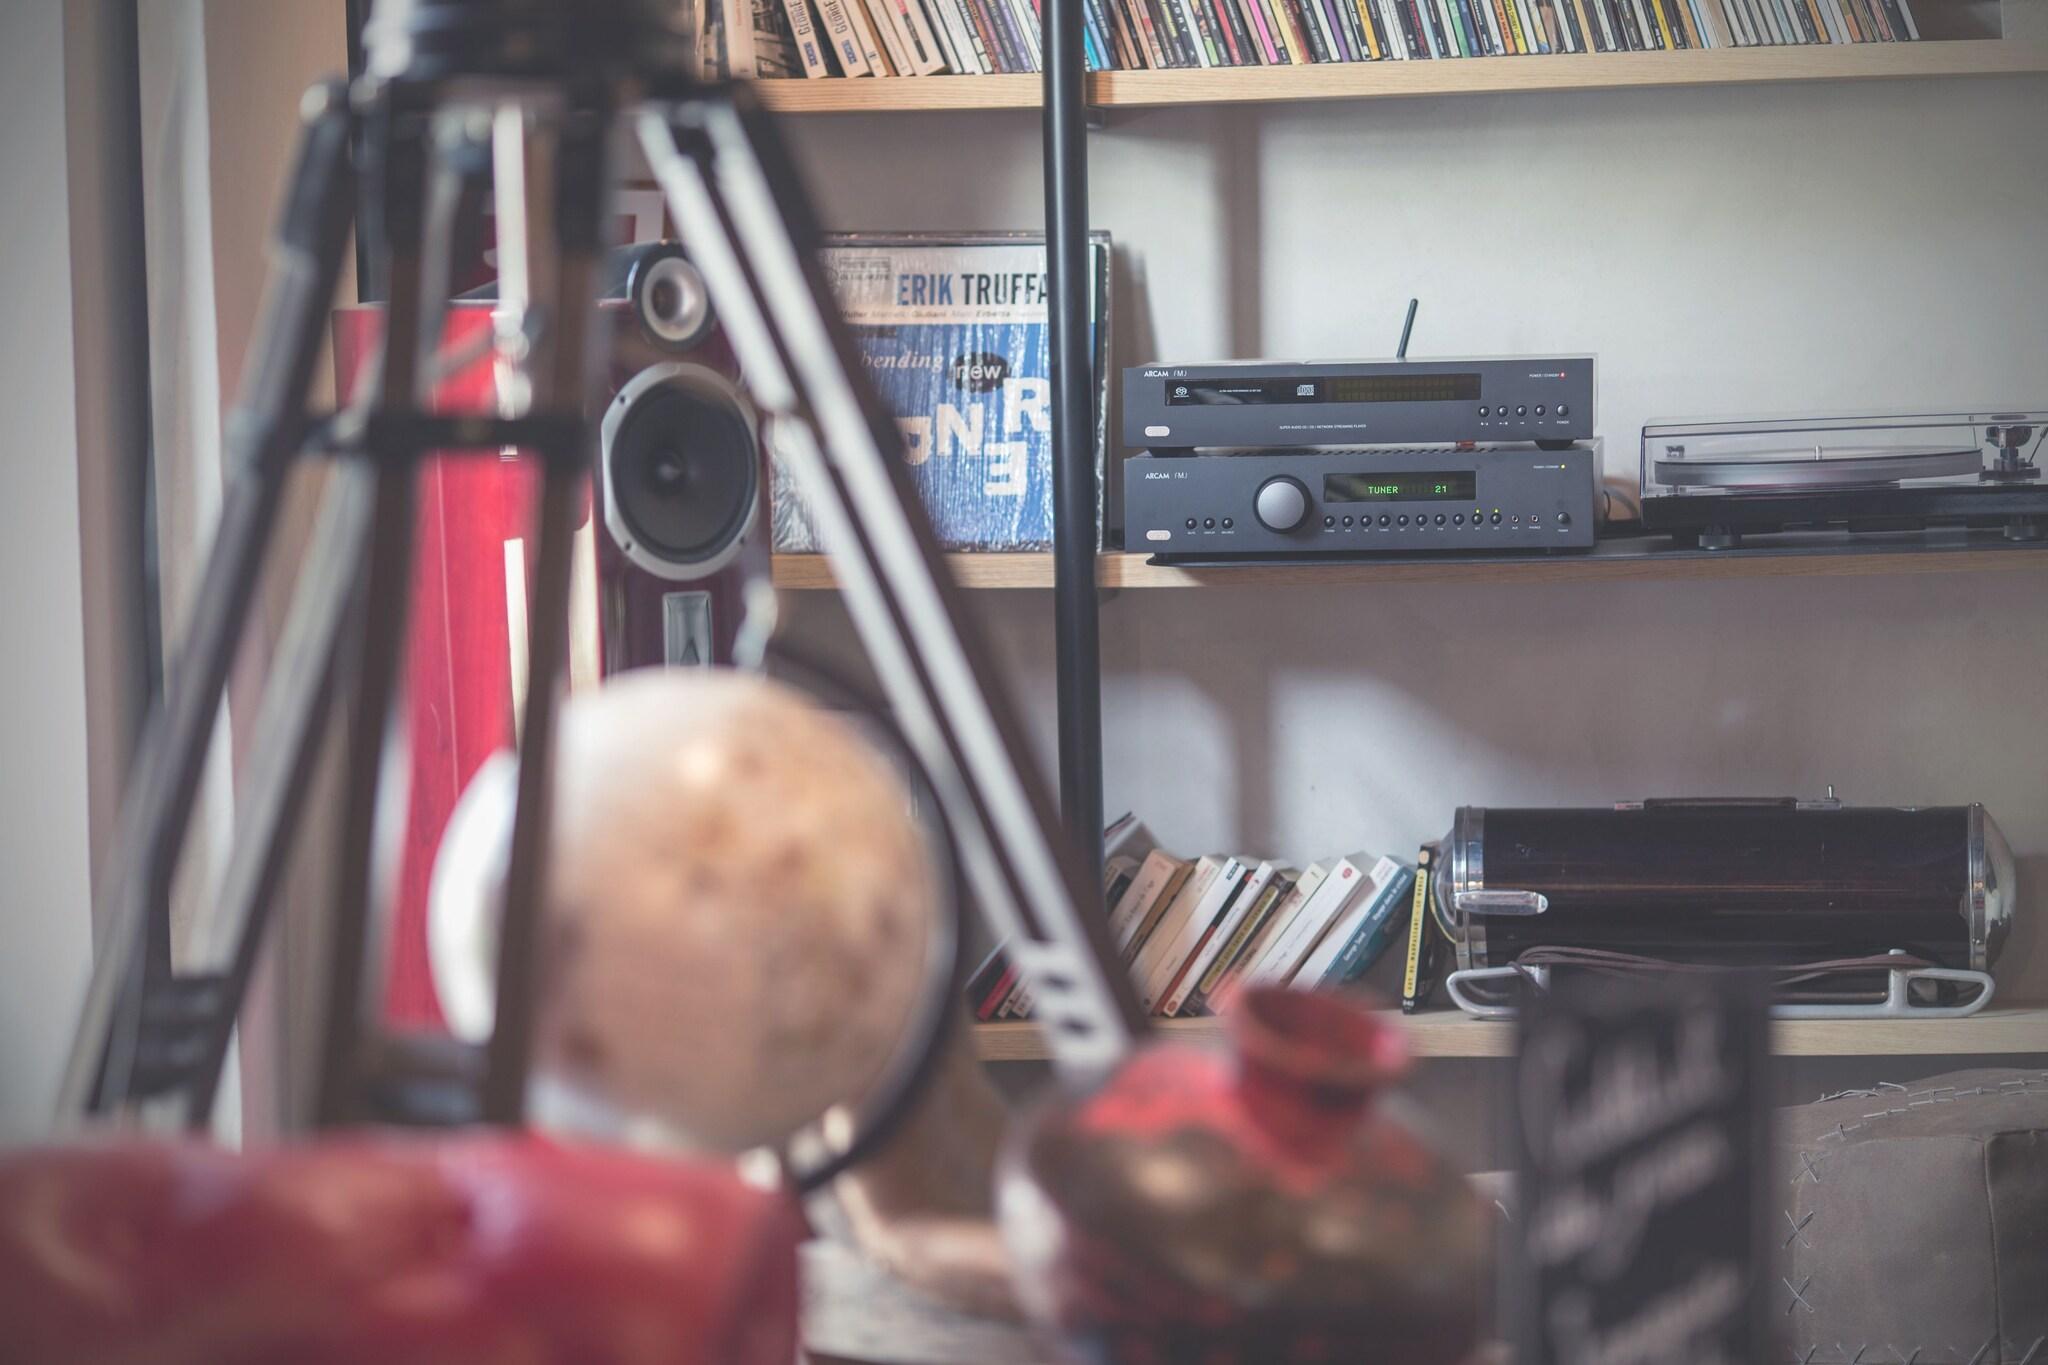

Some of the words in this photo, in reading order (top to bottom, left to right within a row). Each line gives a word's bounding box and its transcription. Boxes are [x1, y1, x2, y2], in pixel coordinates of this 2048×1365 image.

[897, 273, 954, 306] ERIK
[862, 351, 945, 373] bending
[955, 362, 1002, 380] new
[1145, 472, 1170, 480] ARCAM
[1368, 486, 1399, 494] TUNER
[1434, 485, 1448, 493] 21
